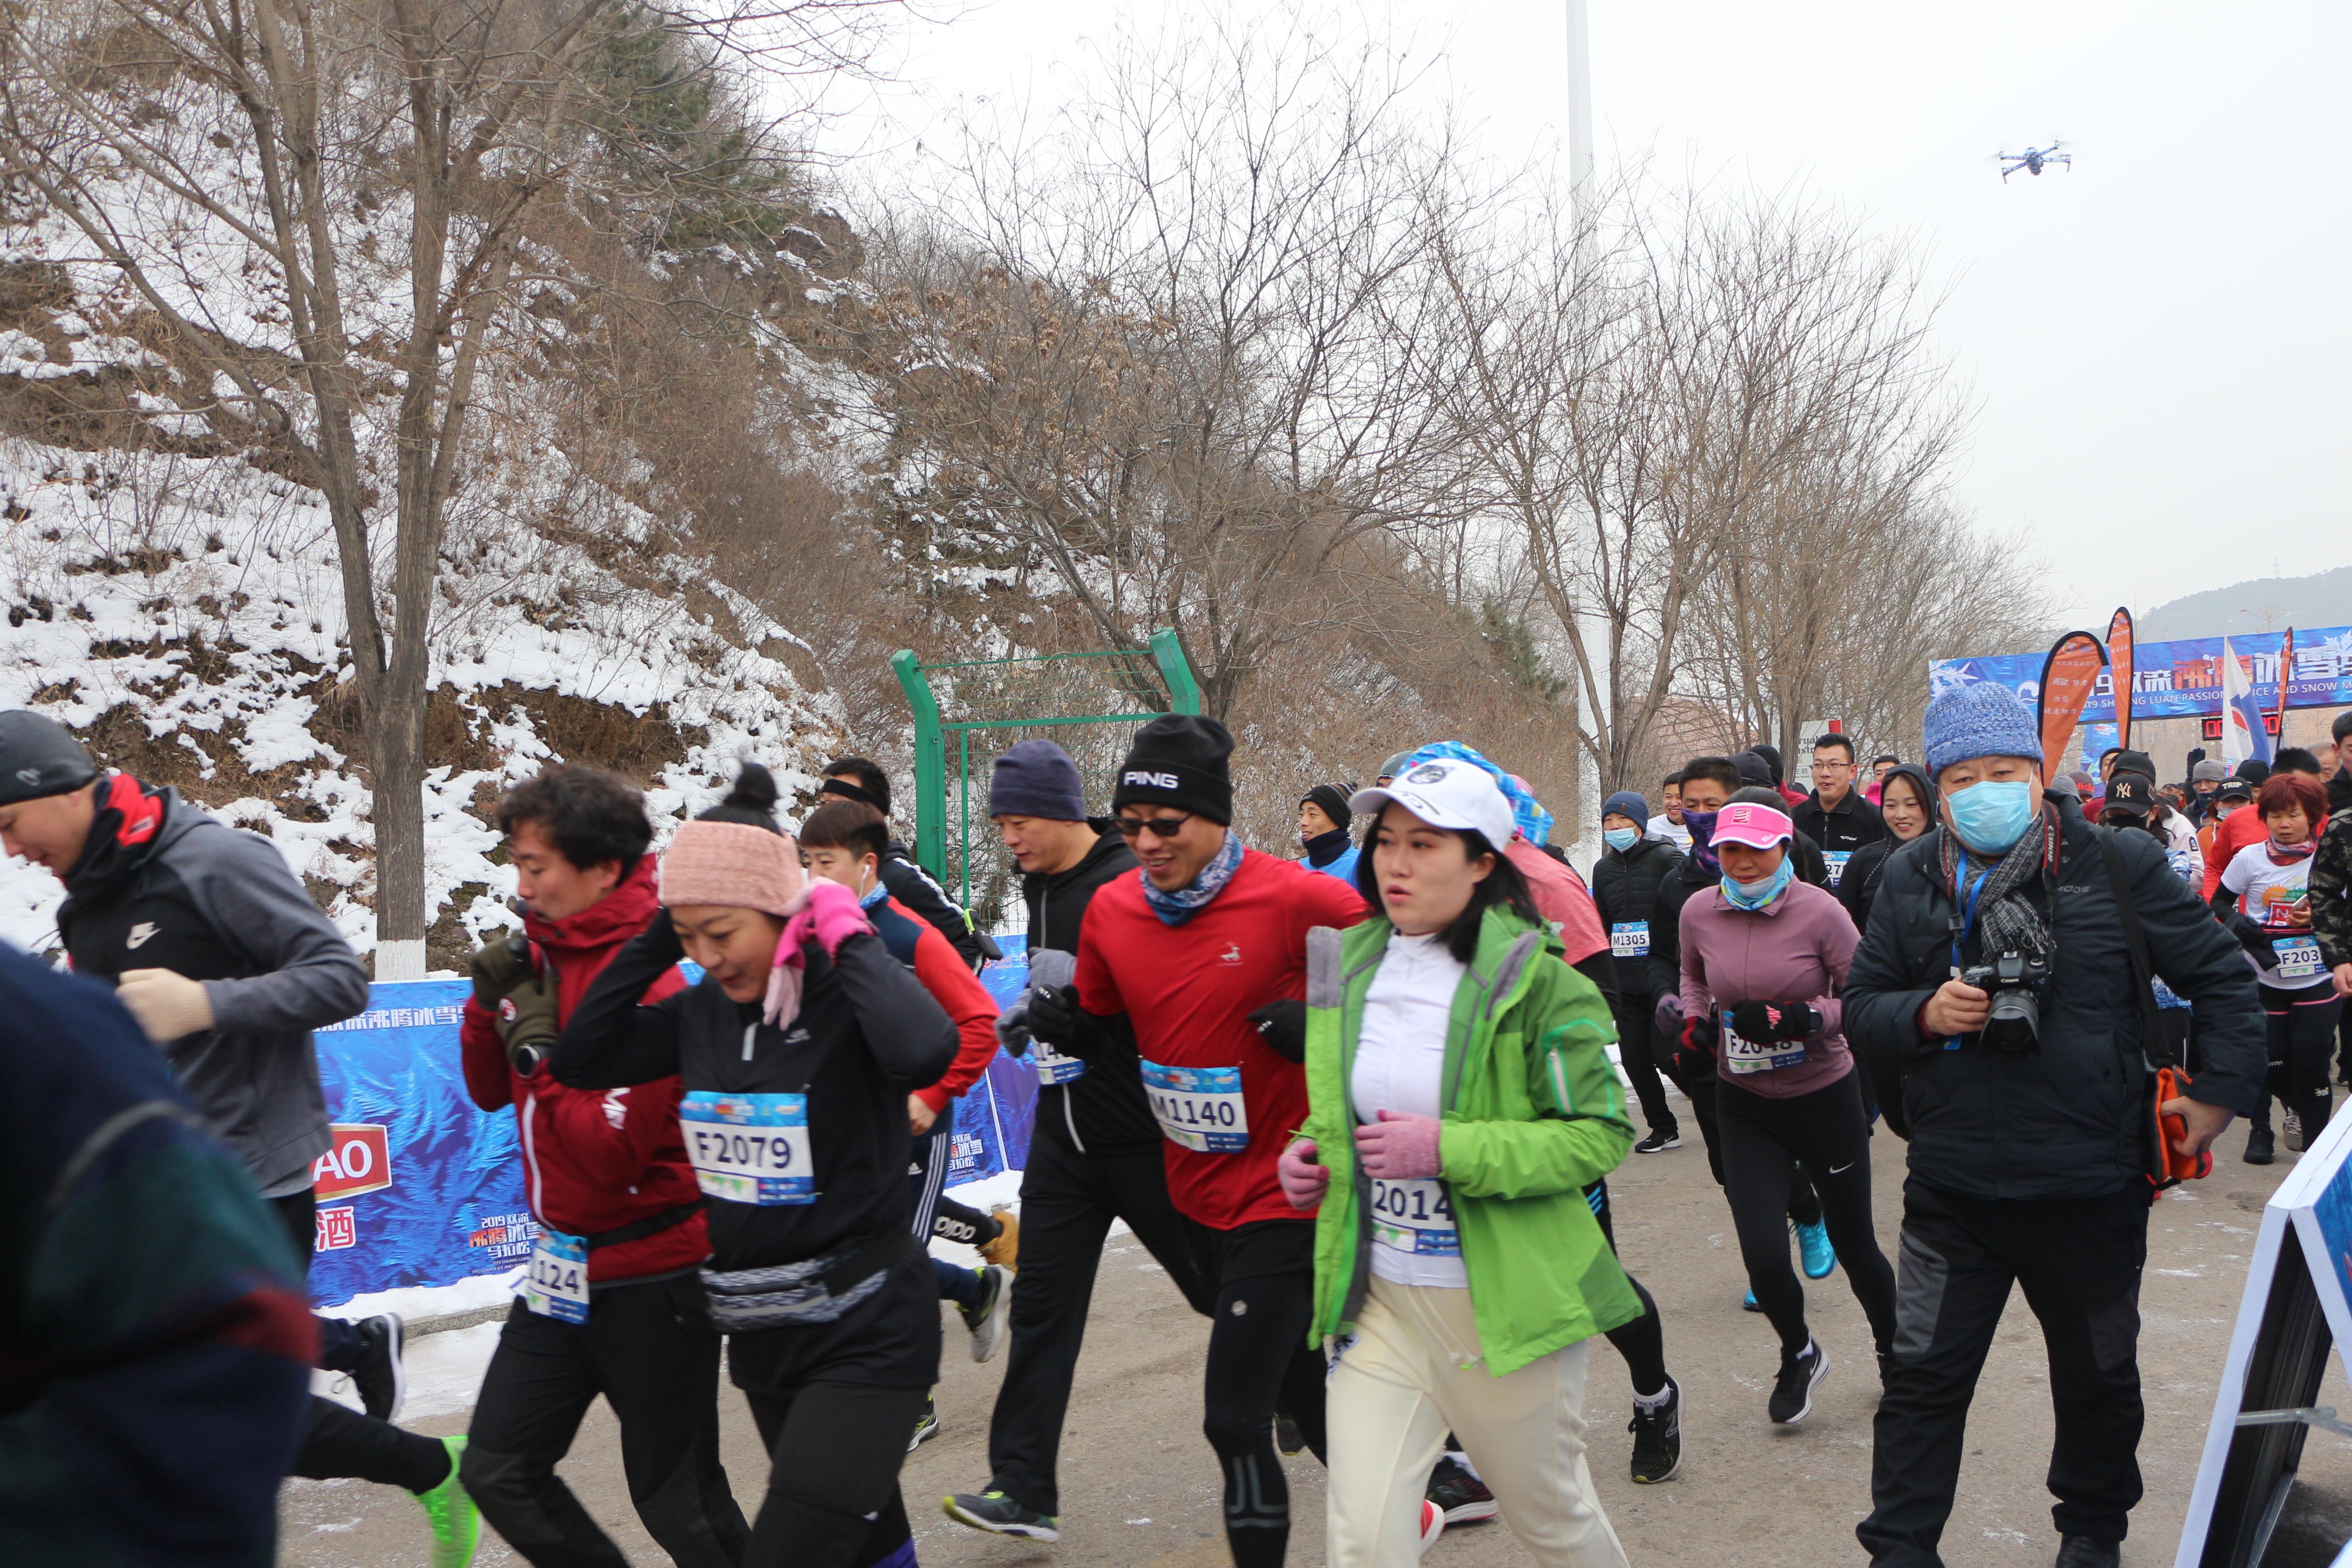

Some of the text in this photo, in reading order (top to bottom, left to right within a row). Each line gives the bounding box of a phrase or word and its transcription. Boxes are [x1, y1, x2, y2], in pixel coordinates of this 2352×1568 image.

[2102, 696, 2146, 708] SHNG
[2150, 694, 2178, 704] LUAN
[2182, 691, 2225, 701] PASSION
[2253, 687, 2269, 696] ICE
[2301, 681, 2337, 693] SNOW
[2342, 681, 2352, 690] M
[1124, 771, 1179, 789] PING
[2222, 781, 2242, 790] TRIP
[2116, 782, 2131, 798] NY
[1613, 935, 1646, 946] M1305
[1149, 1093, 1235, 1126] M1140
[696, 1132, 791, 1169] F2079
[487, 1241, 531, 1259] 马拉松
